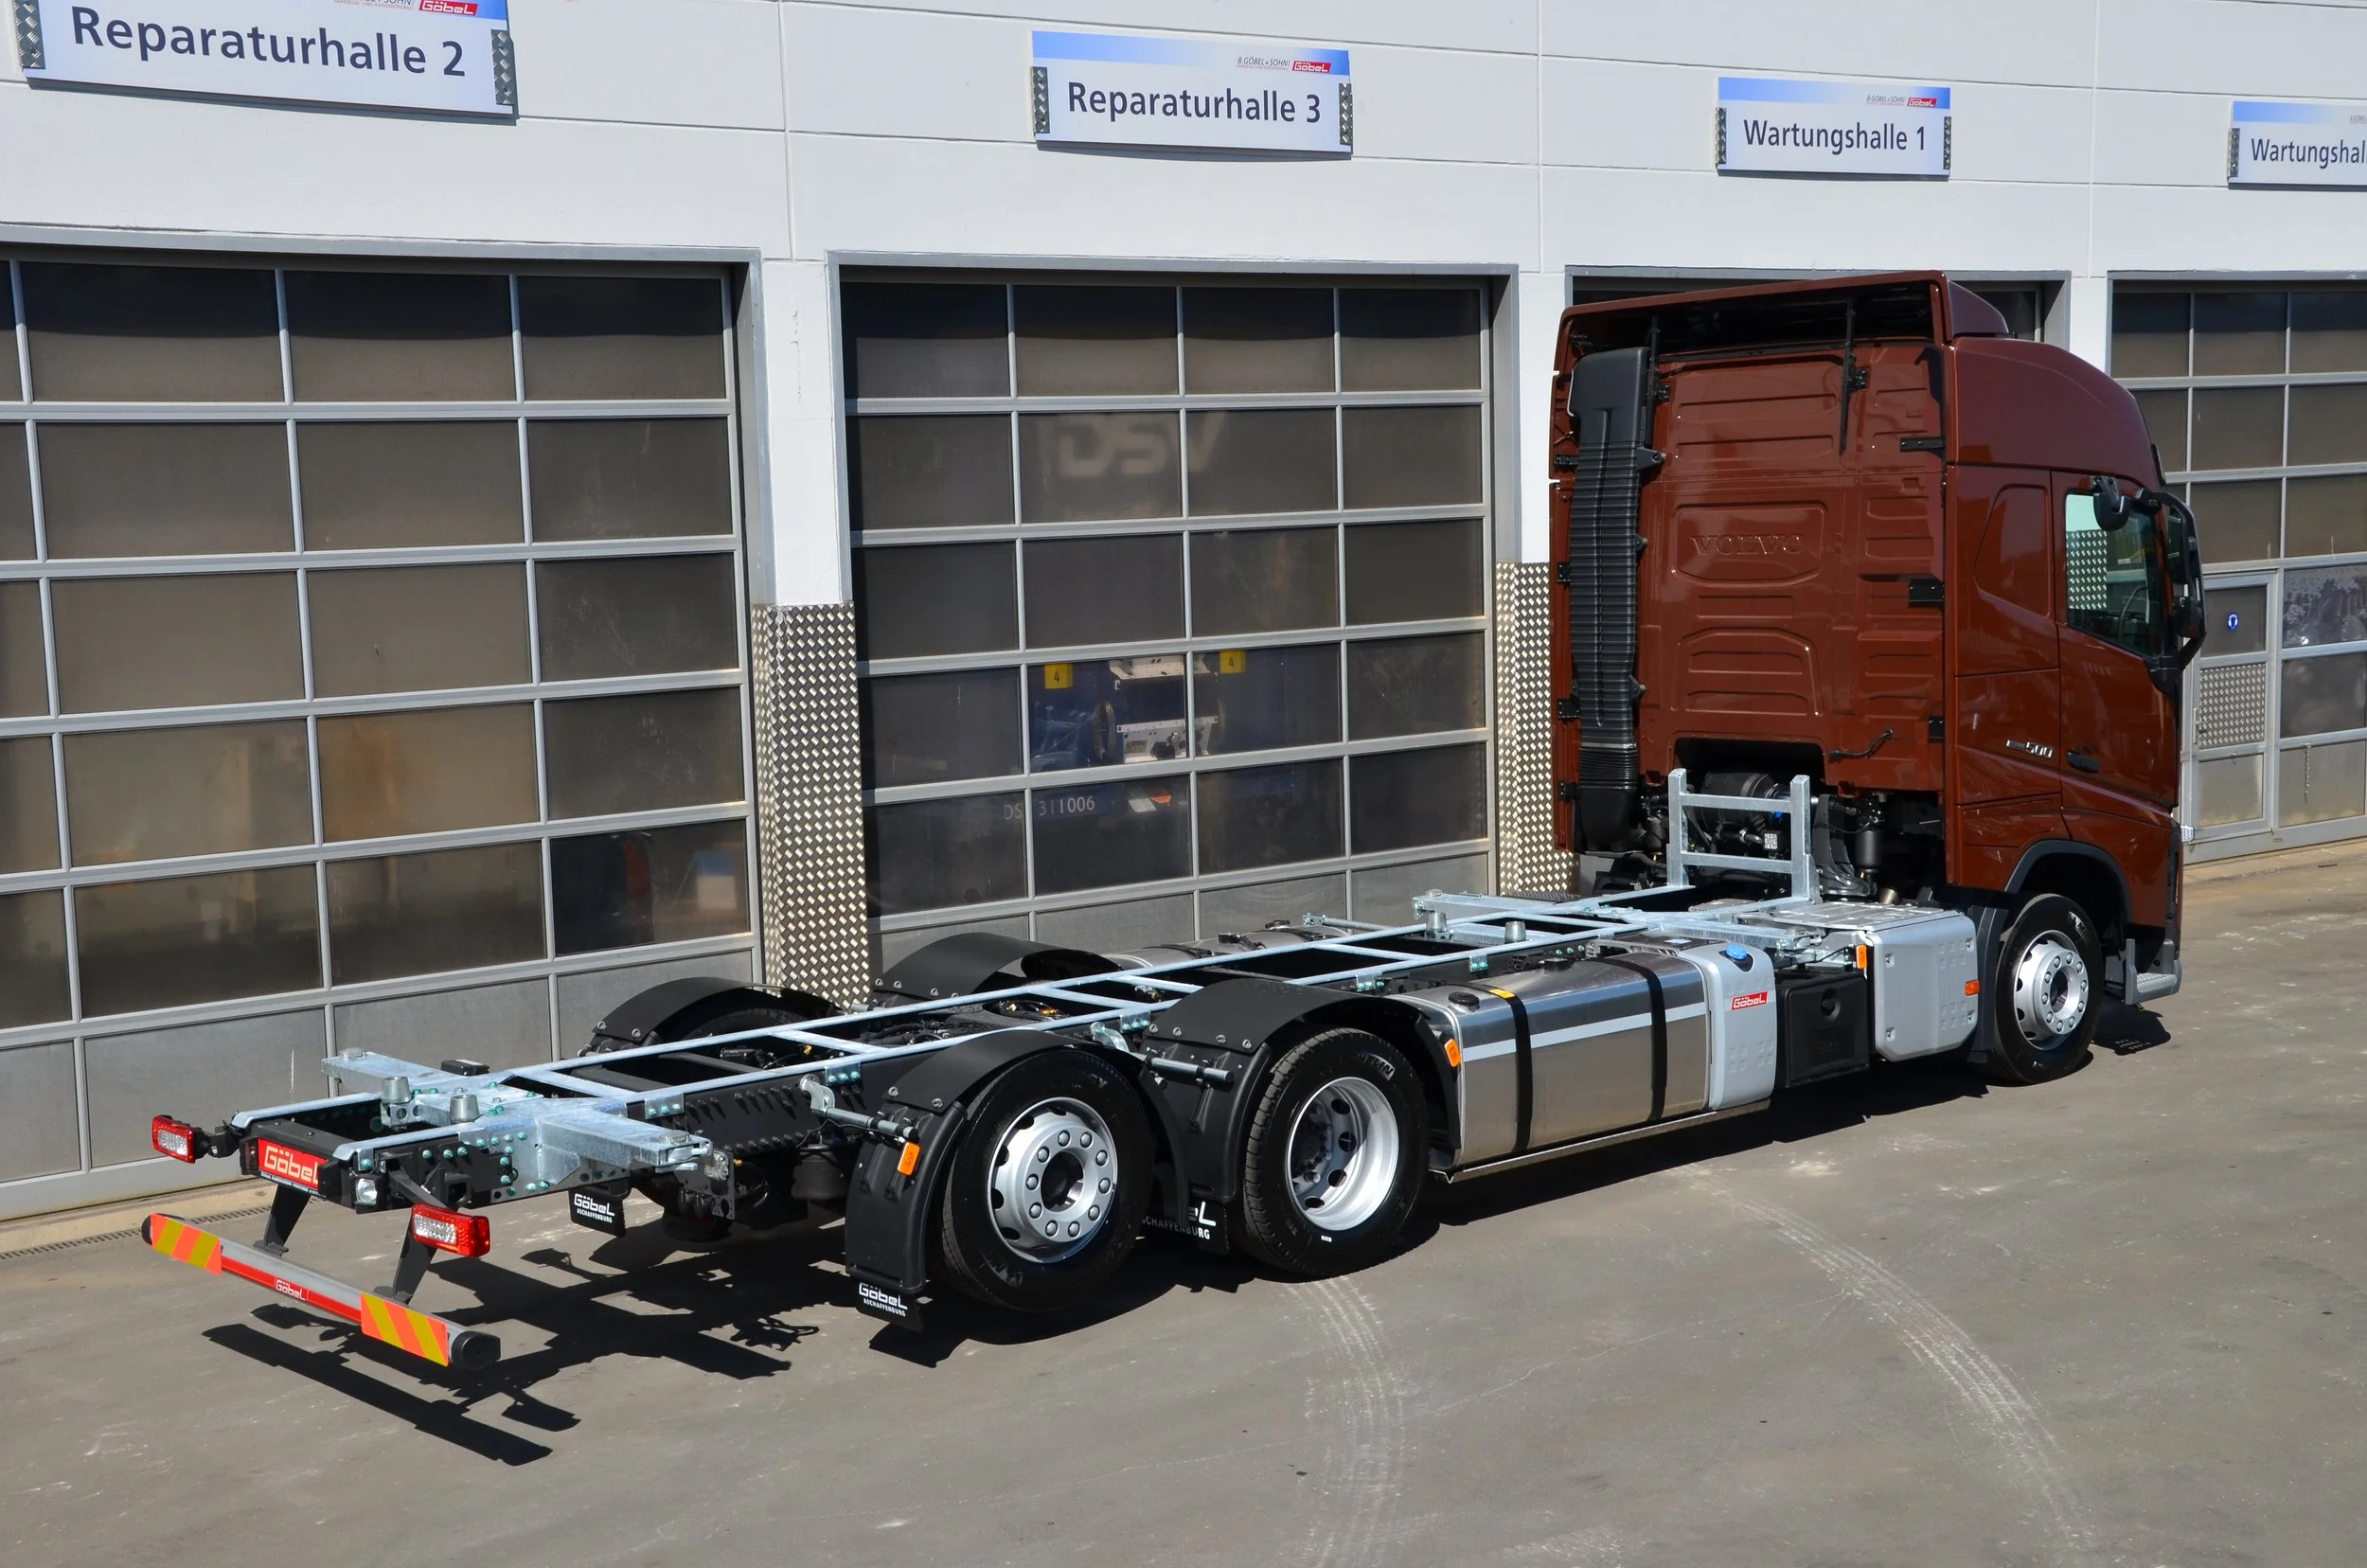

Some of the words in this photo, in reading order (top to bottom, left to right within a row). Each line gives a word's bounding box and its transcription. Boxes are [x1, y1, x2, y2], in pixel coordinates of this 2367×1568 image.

[71, 6, 426, 74] Reparaturhalle
[442, 41, 466, 76] 2
[1293, 62, 1328, 72] Göbel
[1068, 81, 1295, 122] Reparaturhalle
[1306, 94, 1321, 123] 3
[1743, 119, 1908, 155] Wartungshalle
[1916, 126, 1925, 151] 1
[1689, 534, 1804, 556] VOLVO
[1053, 672, 1060, 683] 4
[2025, 741, 2054, 757] 500
[1039, 796, 1095, 816] 311006
[1733, 993, 1766, 1008] Göbel
[264, 1145, 319, 1185] Göbel
[574, 1193, 615, 1217] Göbel
[1142, 1216, 1210, 1239] CHAFFENBURG
[276, 1278, 306, 1301] Göbel
[859, 1282, 908, 1310] Göbel
